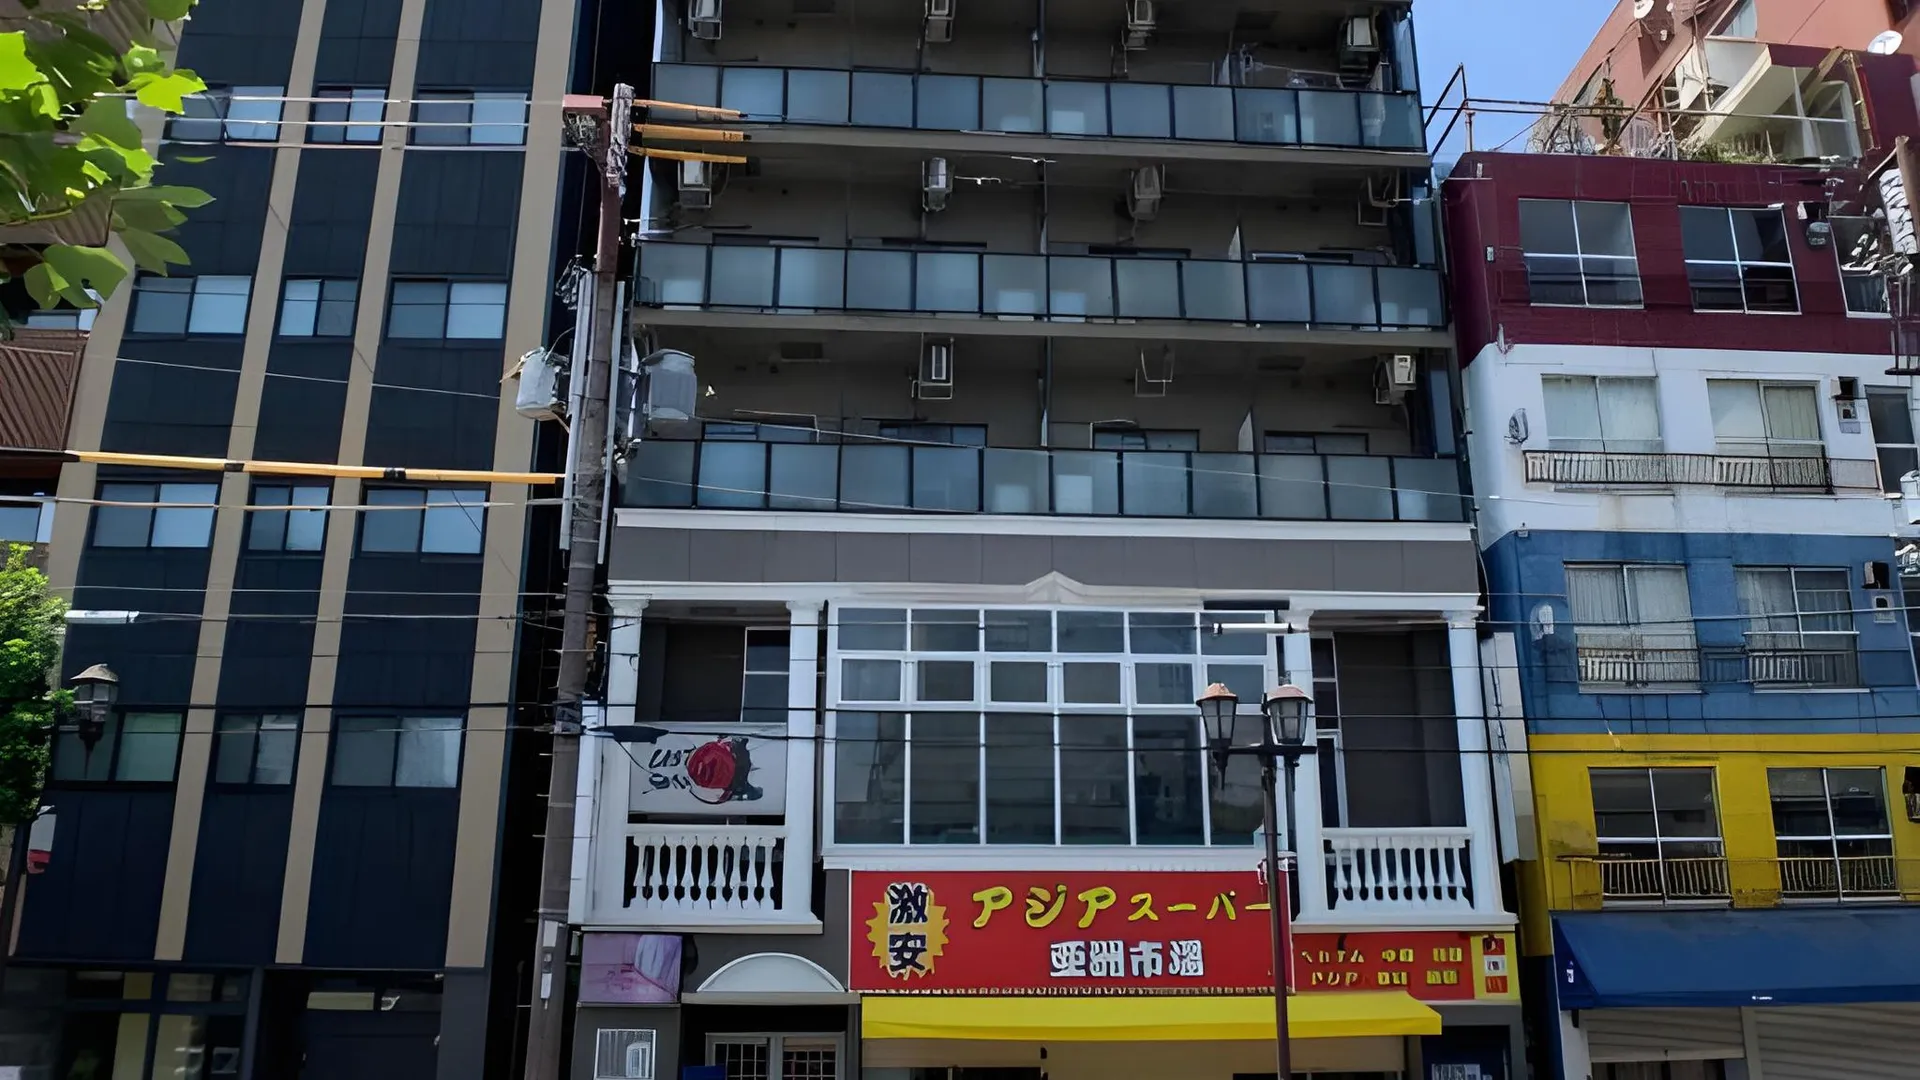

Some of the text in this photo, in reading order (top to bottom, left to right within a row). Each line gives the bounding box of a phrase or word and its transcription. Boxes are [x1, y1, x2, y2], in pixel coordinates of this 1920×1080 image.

[887, 882, 929, 975] 激安
[972, 884, 1272, 929] アジアスーパー
